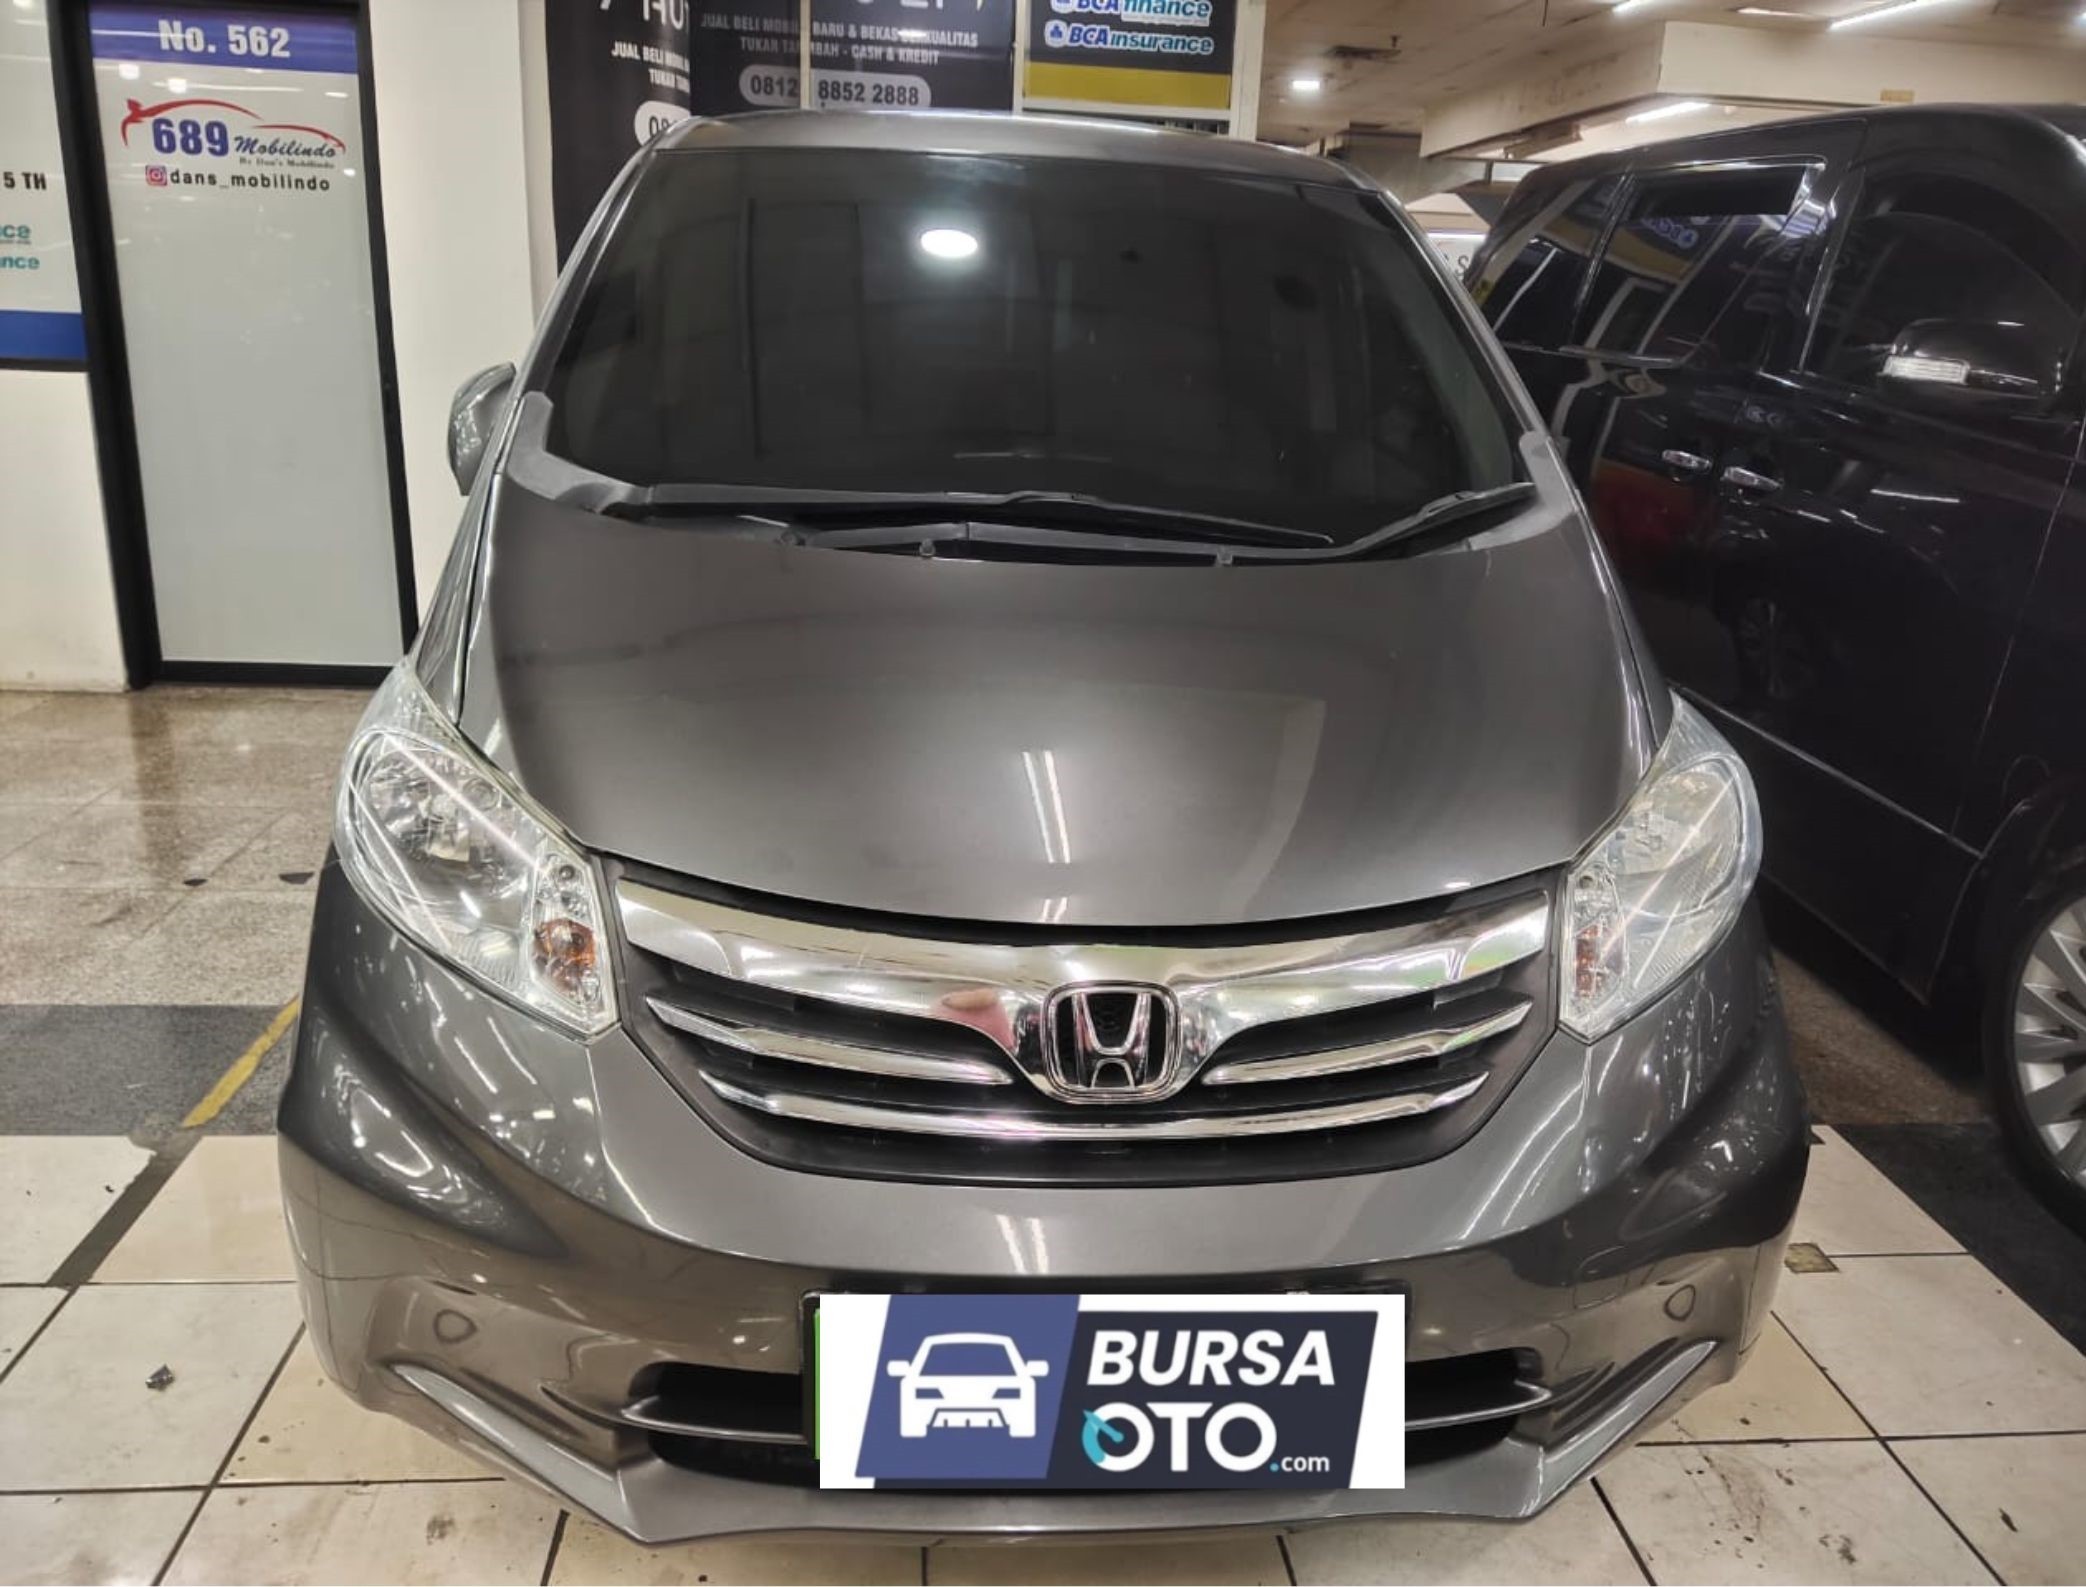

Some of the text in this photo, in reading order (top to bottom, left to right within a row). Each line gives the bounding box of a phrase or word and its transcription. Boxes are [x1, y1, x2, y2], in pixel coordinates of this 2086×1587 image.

[158, 19, 291, 58] No. 562
[701, 13, 730, 29] JUAL
[813, 21, 845, 37] BARU
[861, 25, 898, 41] BEKAS
[611, 40, 640, 60] JUAL
[751, 75, 919, 105] 0812 8852 2888
[152, 118, 229, 156] 689
[234, 135, 337, 158] Mobilindo
[3, 171, 46, 190] 5 TH
[170, 169, 330, 191] dans_mobilindo
